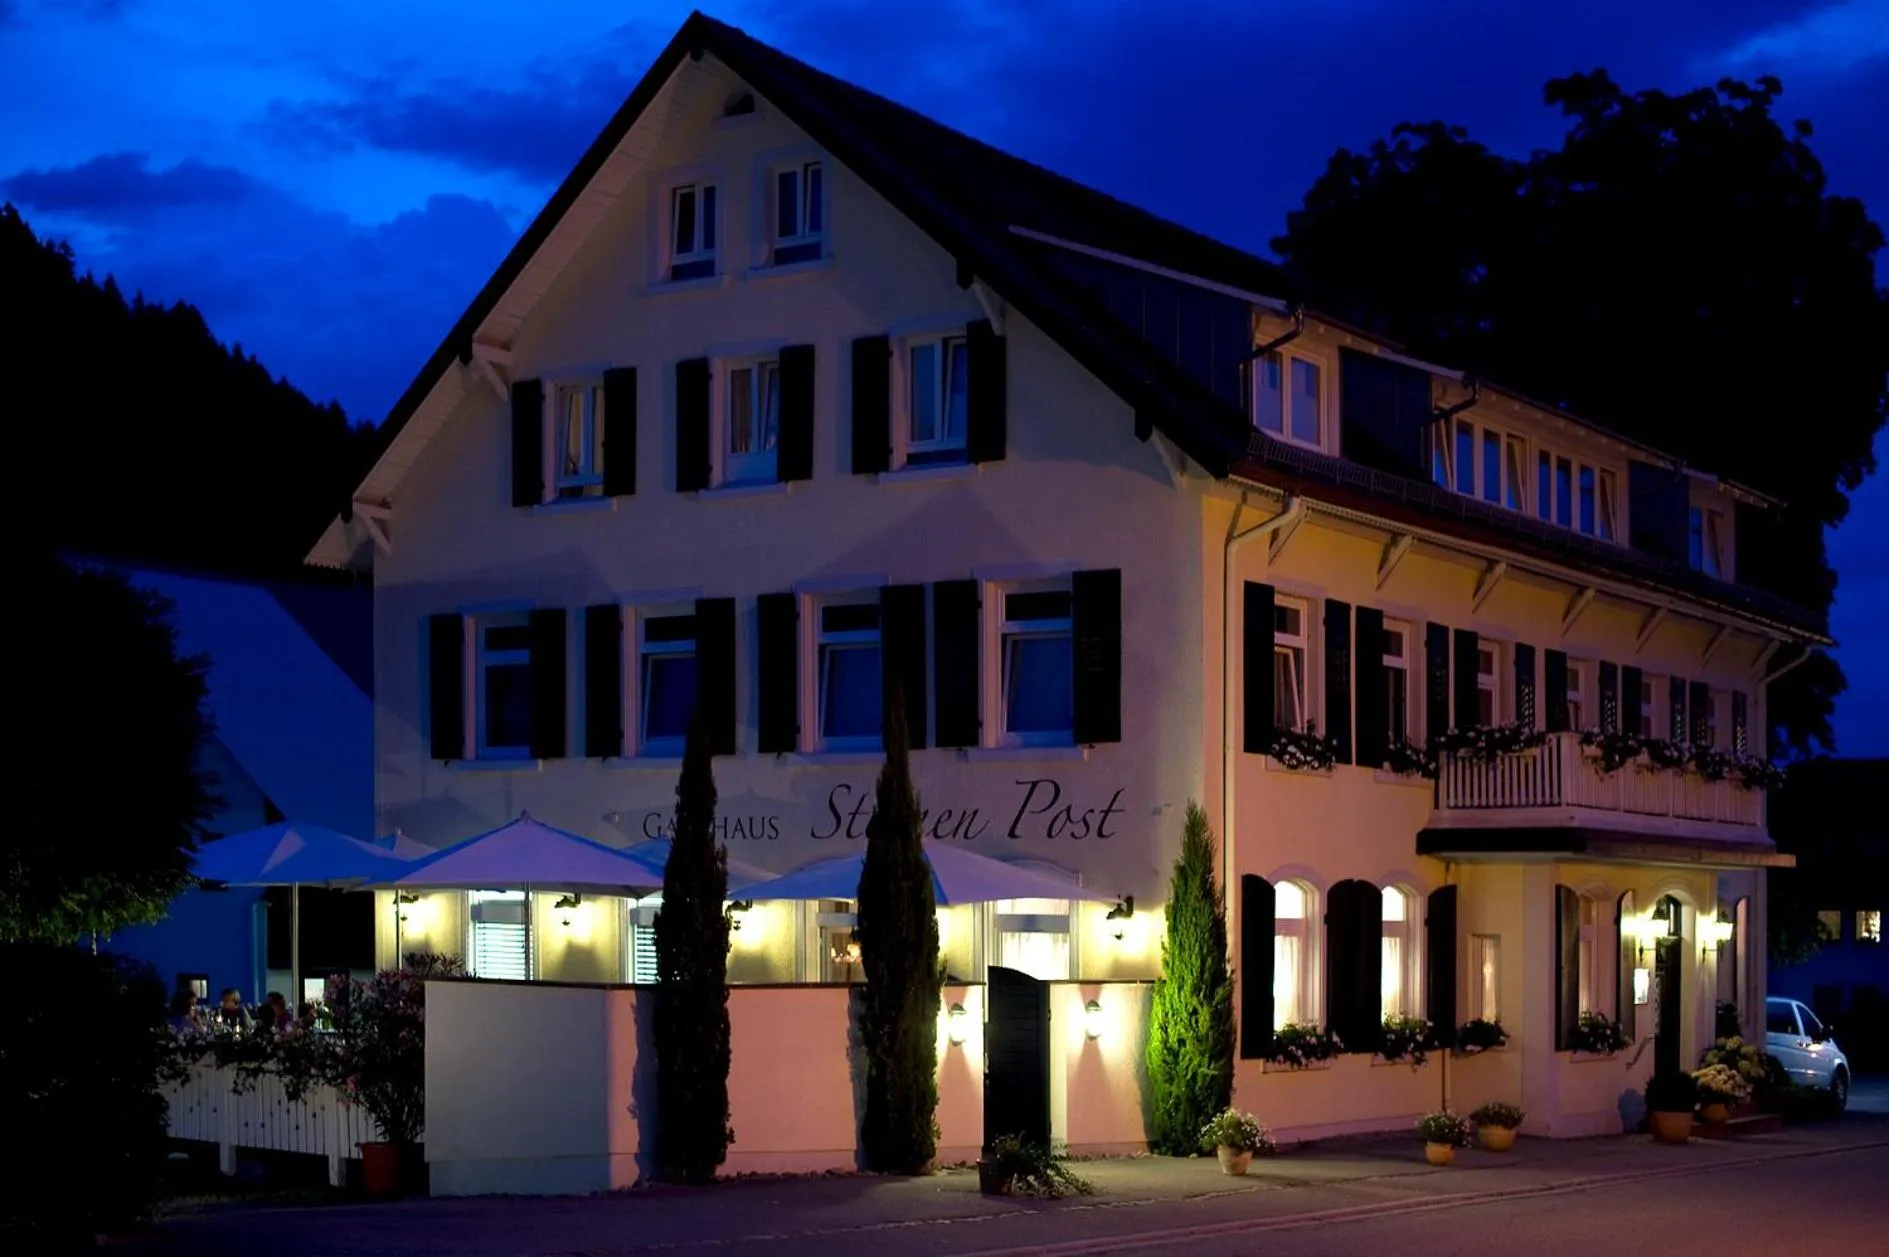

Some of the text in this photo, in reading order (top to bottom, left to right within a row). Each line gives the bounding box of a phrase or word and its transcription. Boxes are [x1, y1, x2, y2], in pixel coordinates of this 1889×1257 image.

[643, 779, 1125, 841] GAHAUS Sten Post
